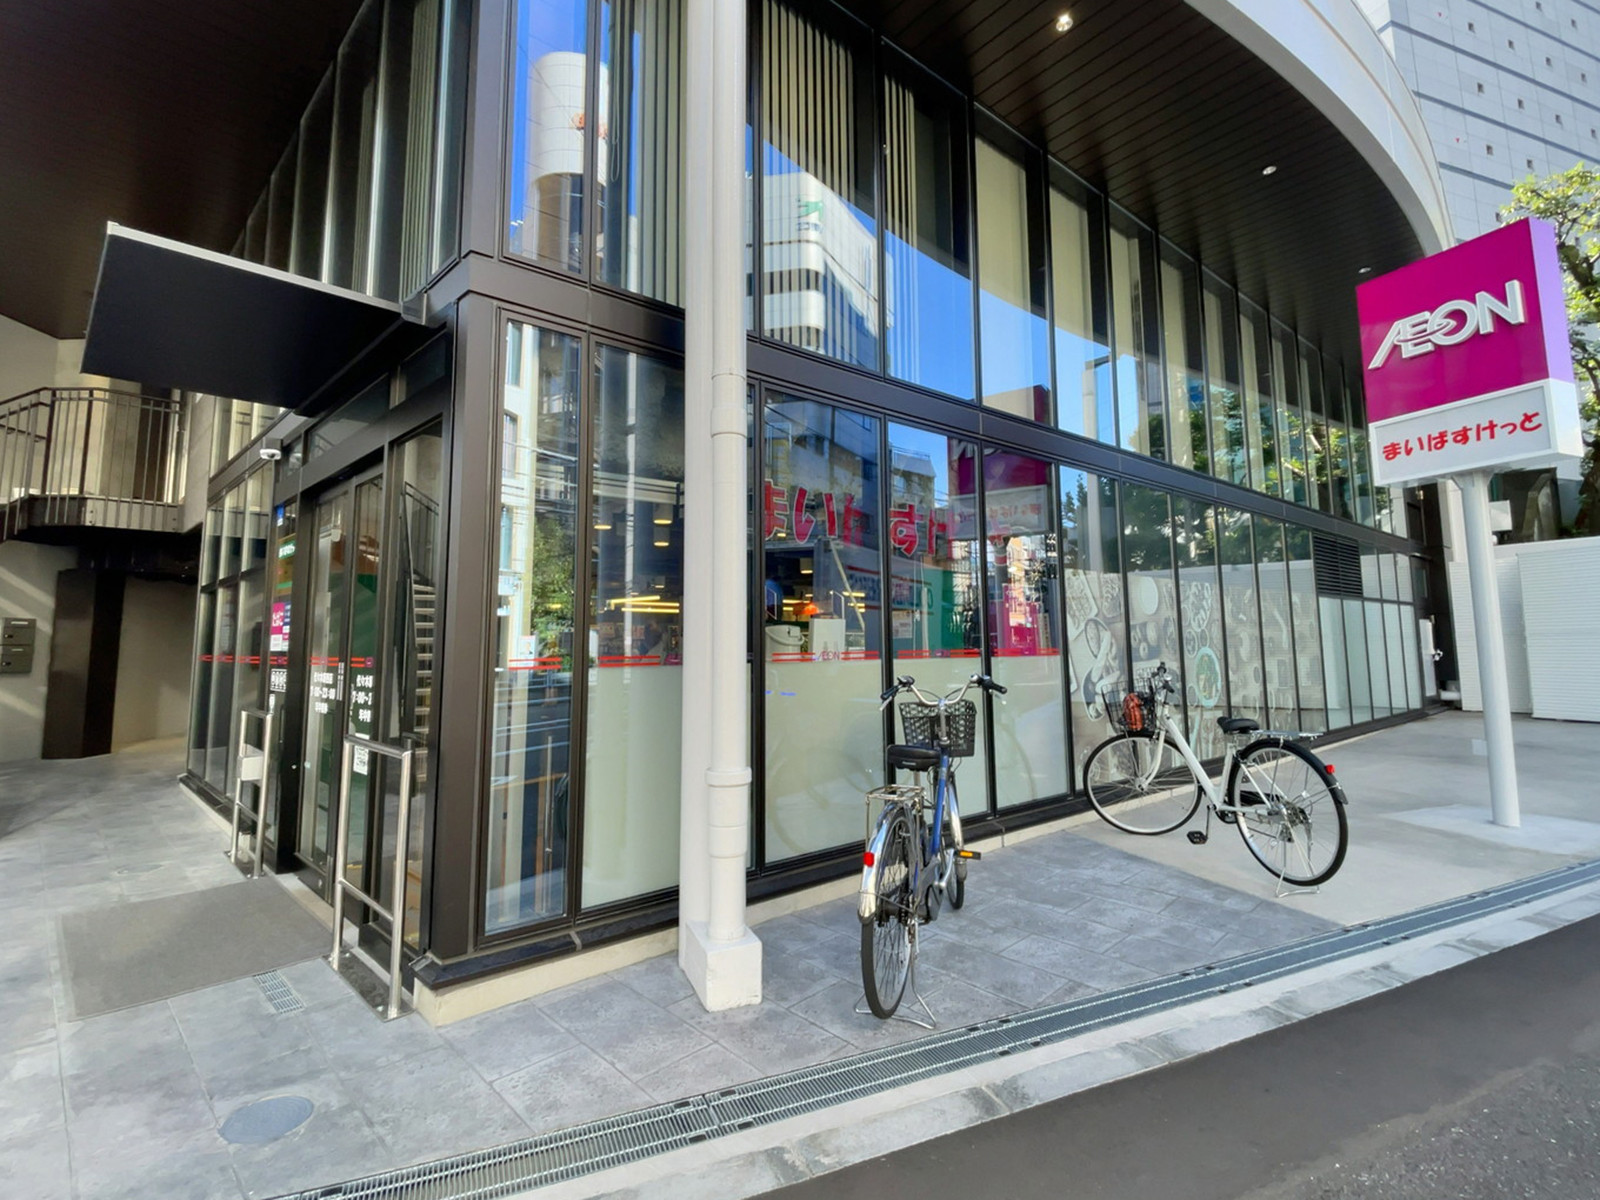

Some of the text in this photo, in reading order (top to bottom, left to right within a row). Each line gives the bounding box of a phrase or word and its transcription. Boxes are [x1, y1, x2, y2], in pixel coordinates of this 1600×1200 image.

[1382, 411, 1543, 462] まいばすけっと
